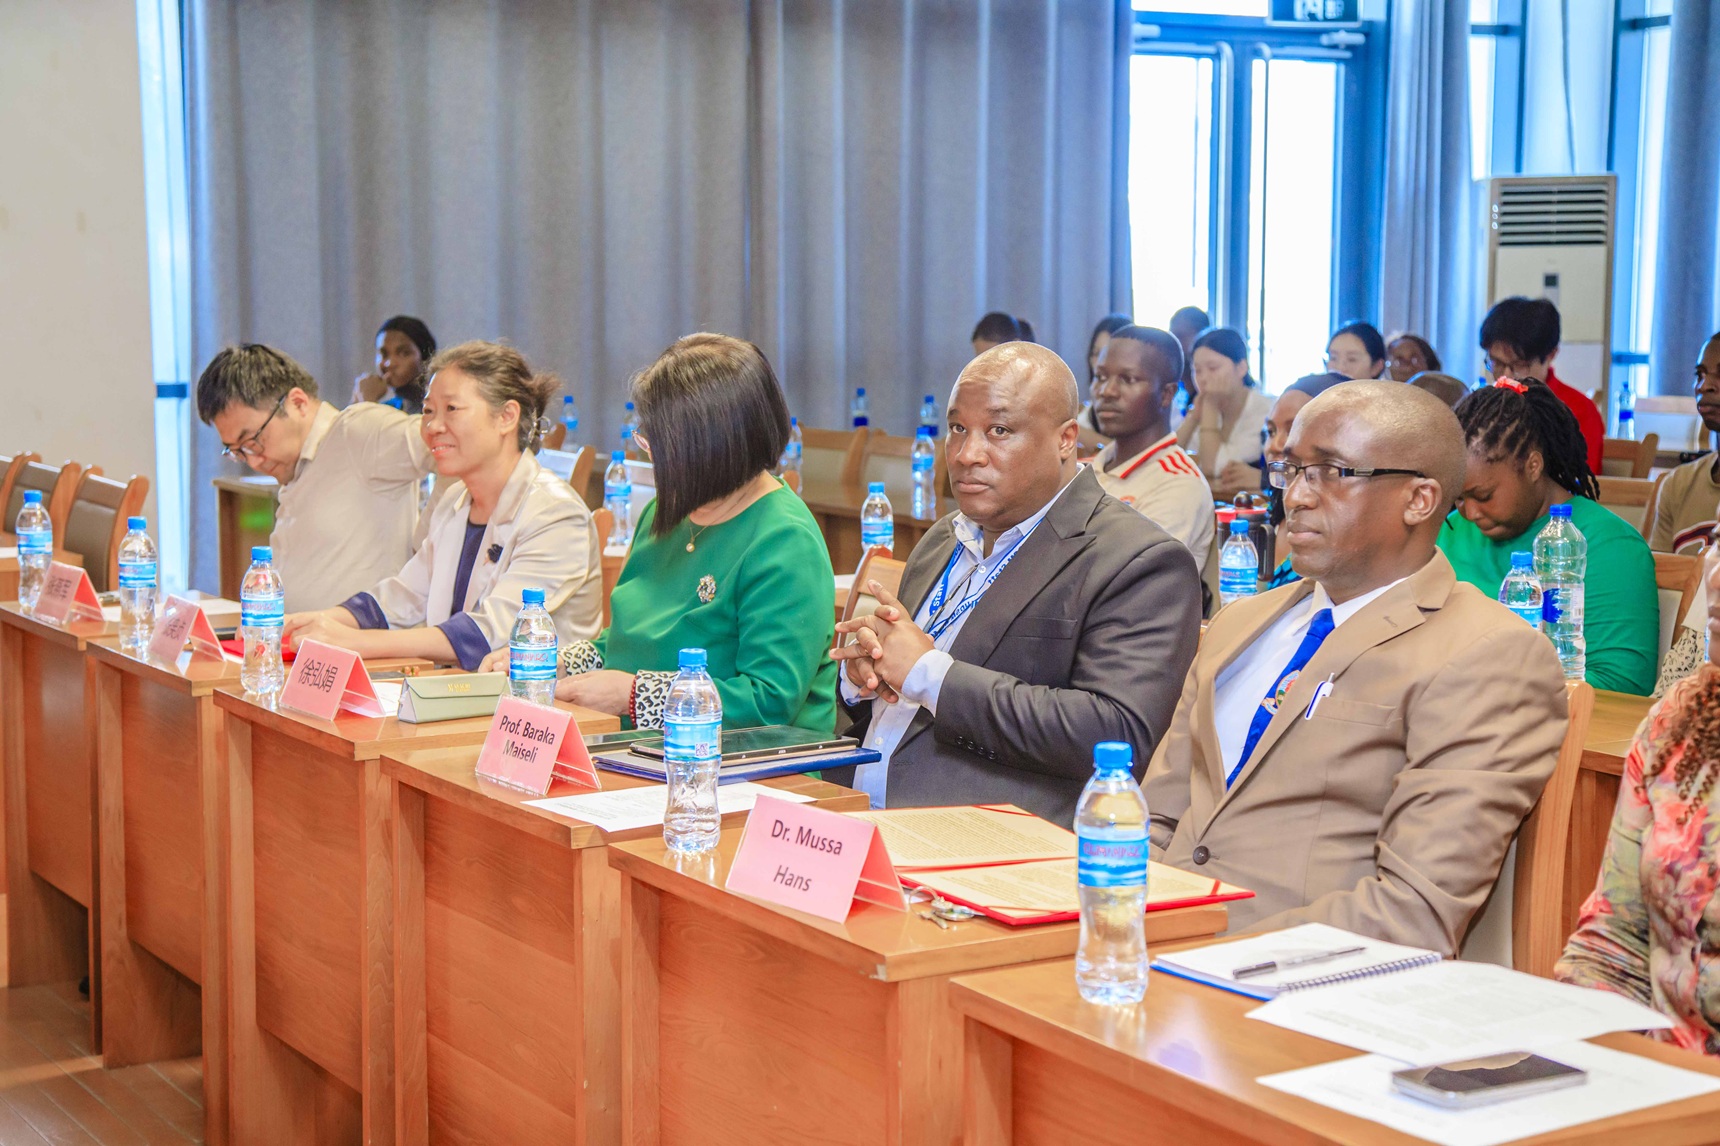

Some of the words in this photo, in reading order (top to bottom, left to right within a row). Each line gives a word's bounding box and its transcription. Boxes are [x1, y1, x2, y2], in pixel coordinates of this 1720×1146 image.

[499, 715, 522, 735] Prof.
[522, 722, 555, 745] Baraka
[503, 739, 538, 763] Maiseli
[771, 819, 790, 842] Dr.
[795, 826, 843, 855] Mussa
[773, 865, 812, 892] Hans
